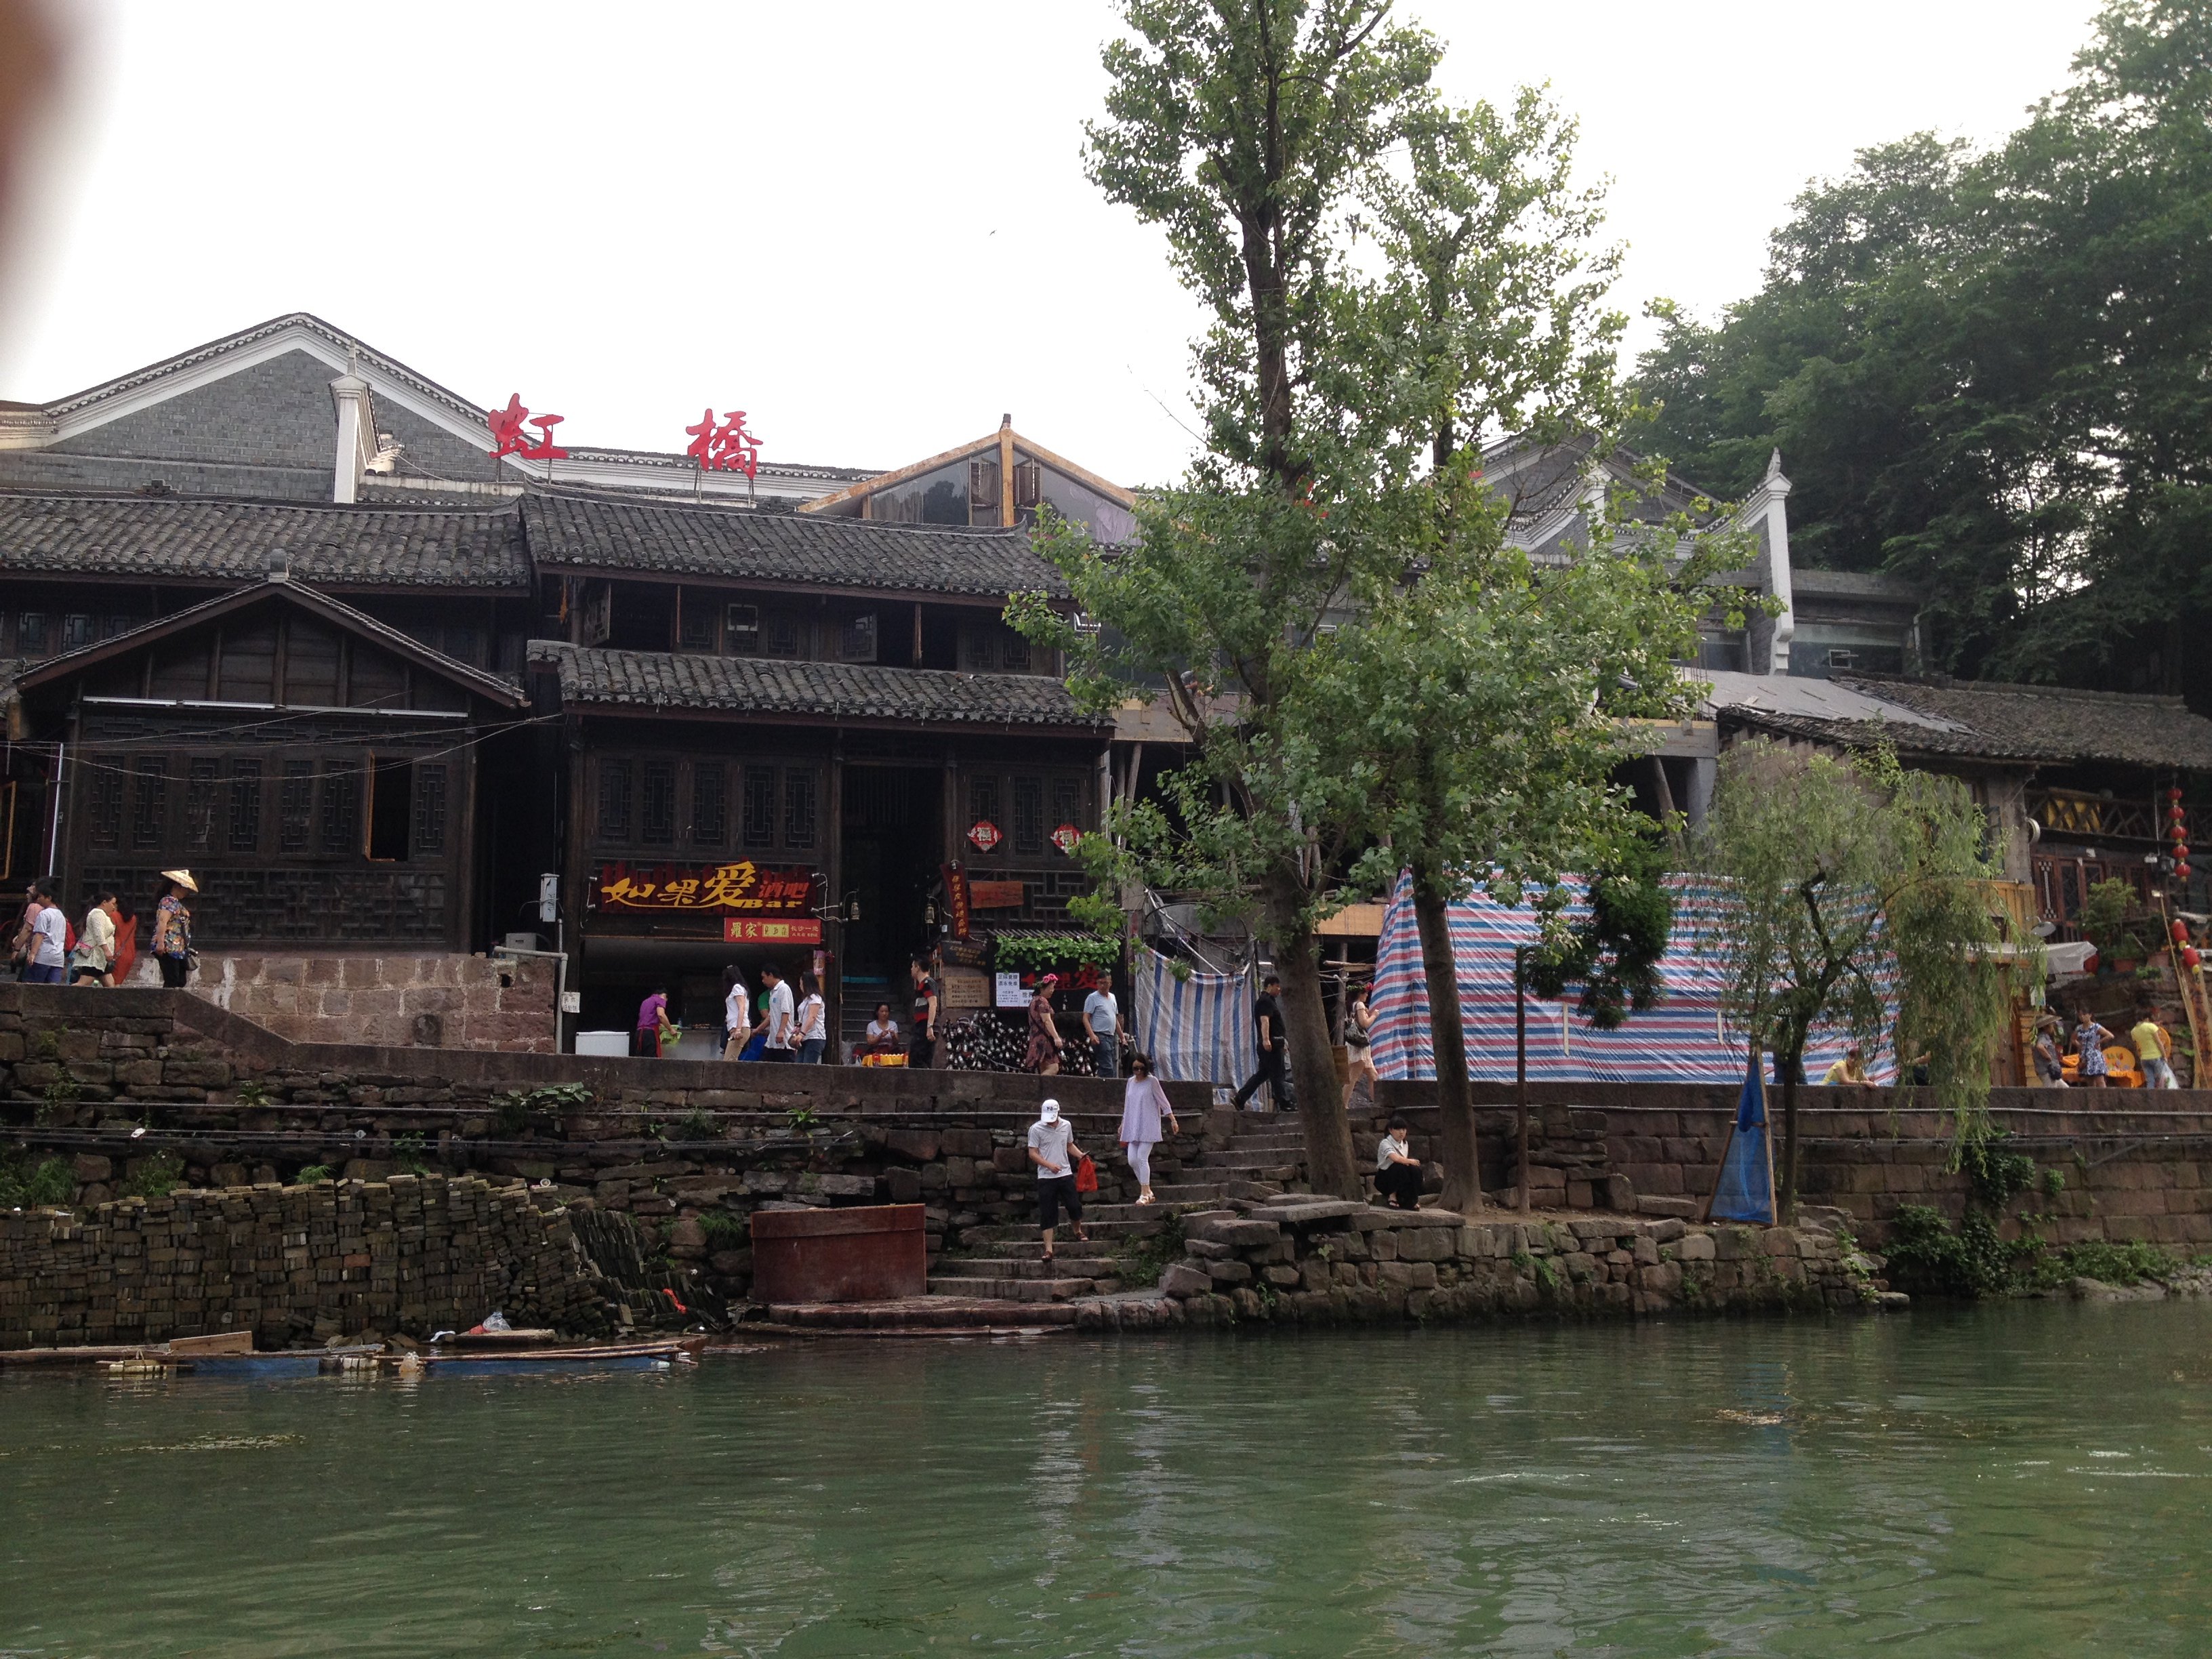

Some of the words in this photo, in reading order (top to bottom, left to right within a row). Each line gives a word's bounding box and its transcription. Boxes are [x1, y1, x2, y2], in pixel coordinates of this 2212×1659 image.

[601, 861, 756, 908] 如果爱
[758, 882, 809, 898] 酒吧
[743, 899, 802, 908] Bar
